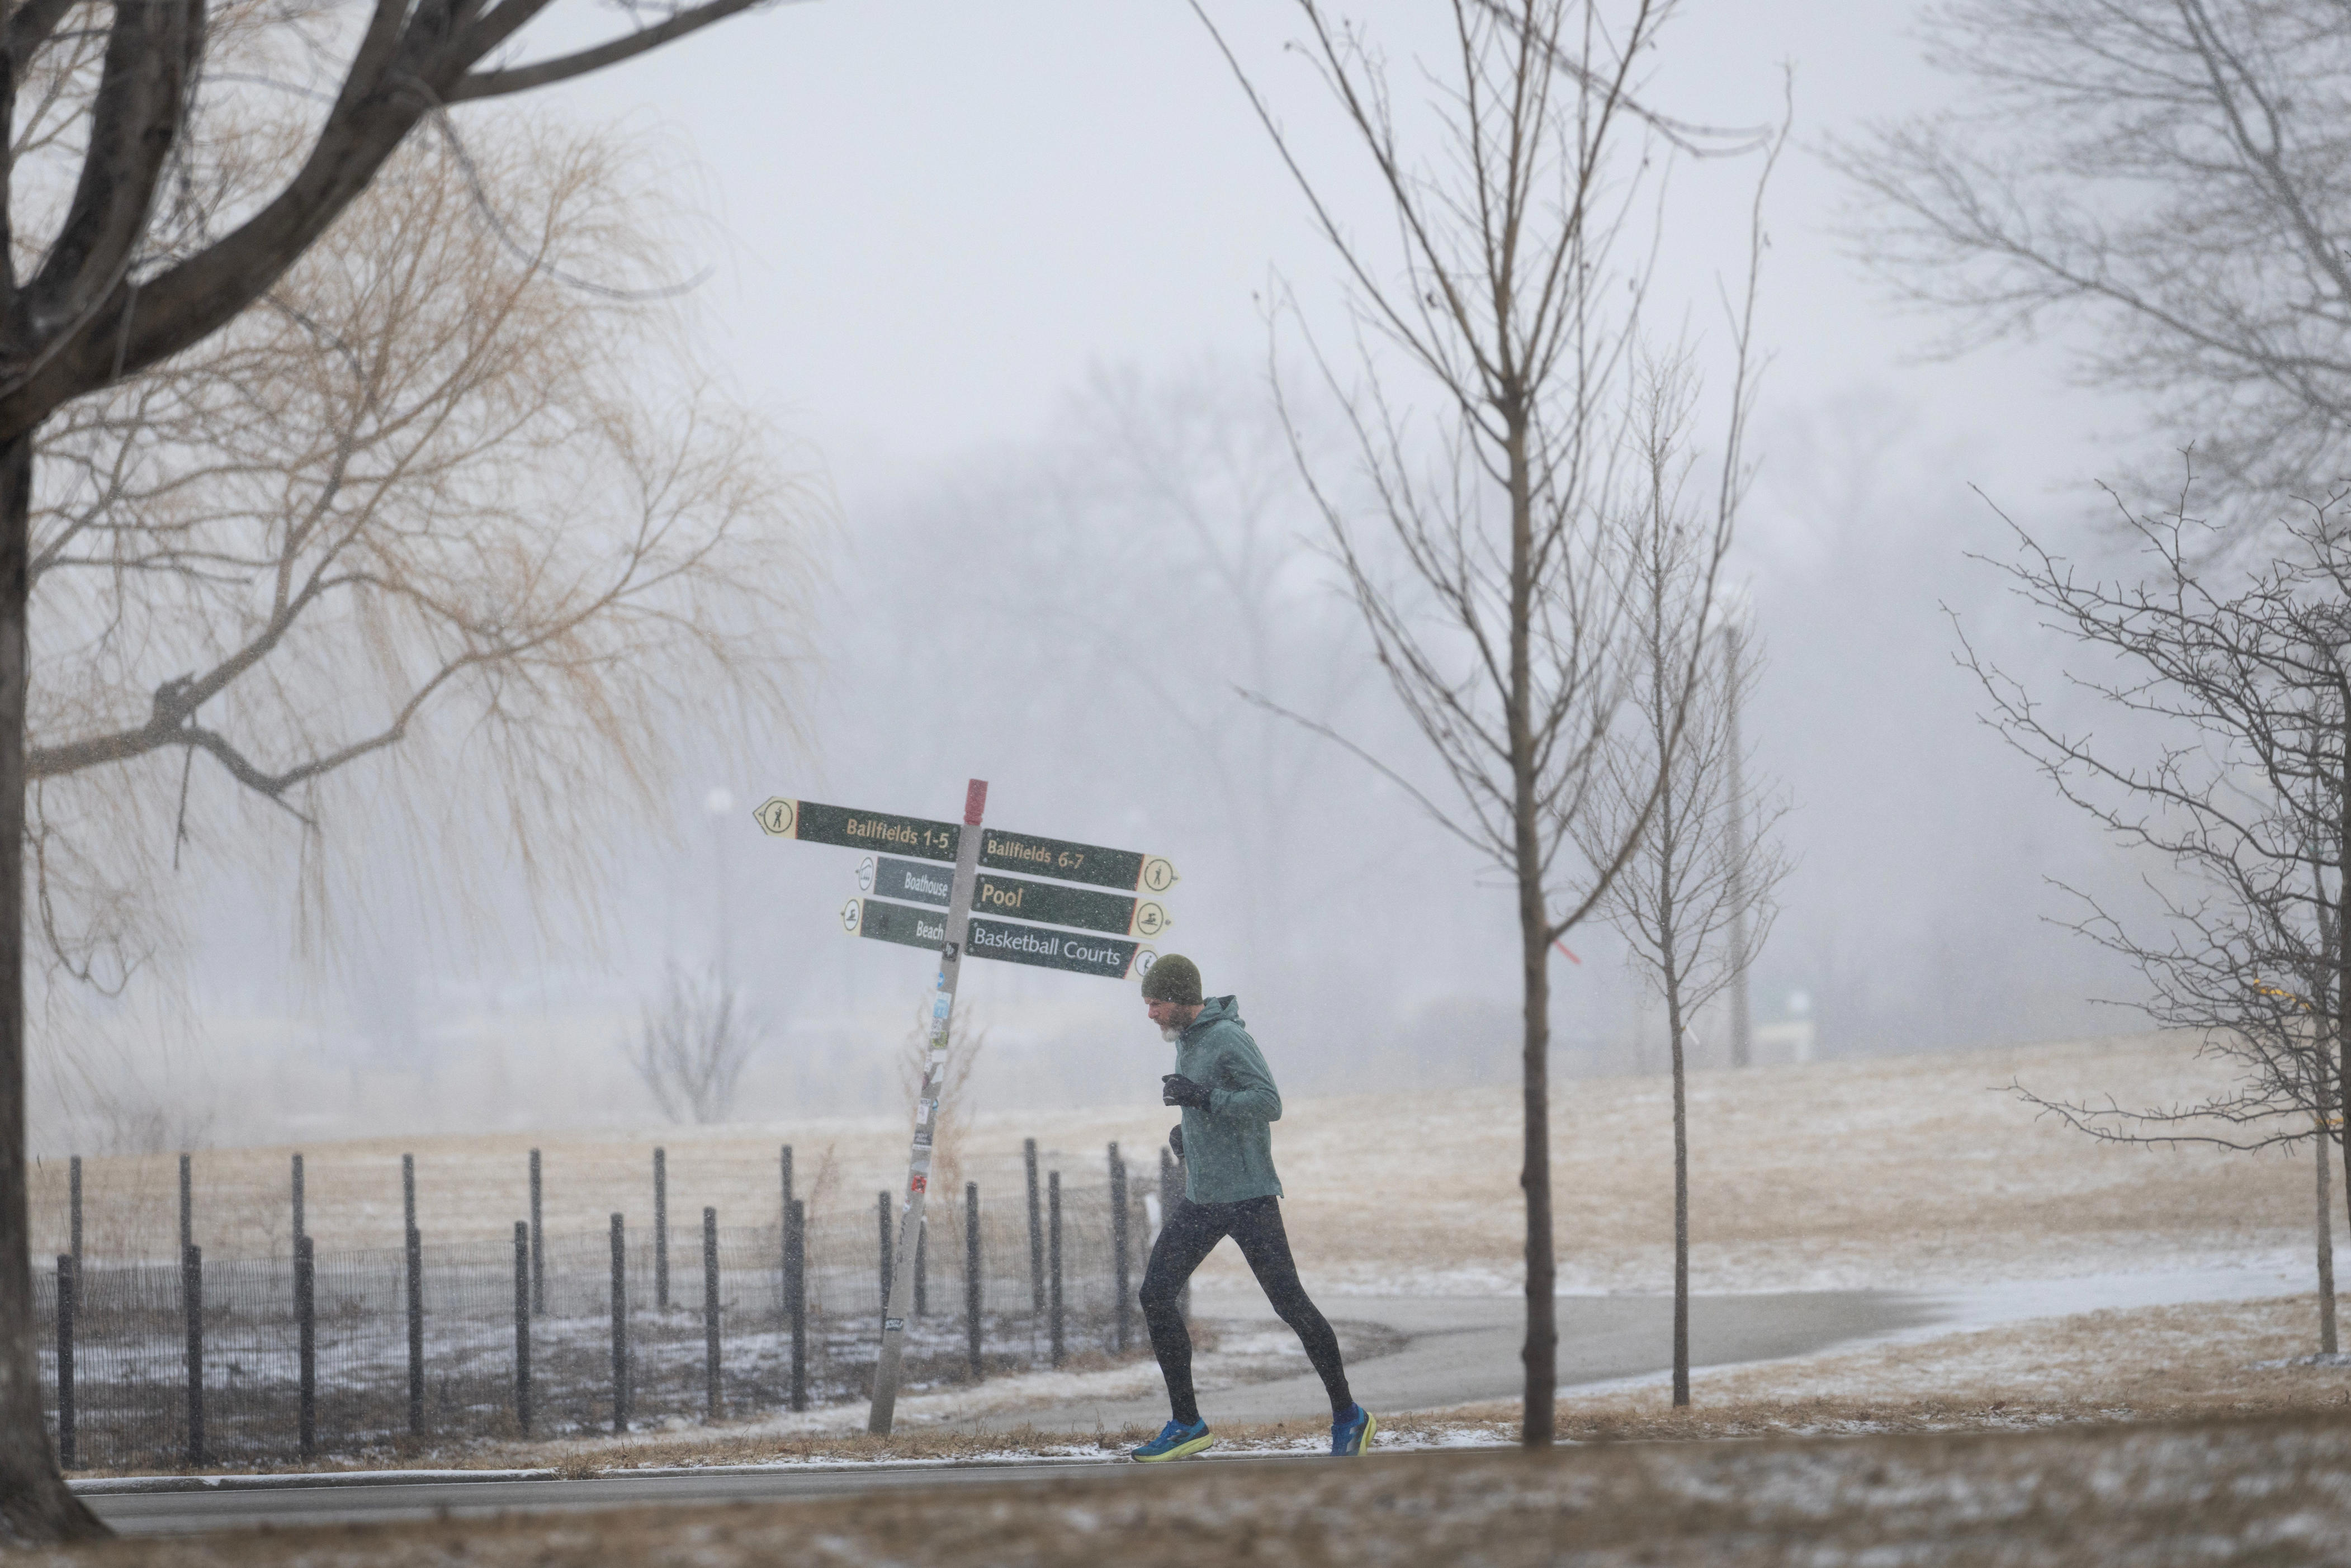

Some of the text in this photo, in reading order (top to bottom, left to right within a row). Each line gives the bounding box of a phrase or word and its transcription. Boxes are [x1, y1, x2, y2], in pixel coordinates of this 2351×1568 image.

[846, 818, 949, 849] Ballfields 1-5
[987, 839, 1085, 869] Ballfields 6-7
[904, 871, 948, 897] Boathouse
[981, 883, 1024, 908] Pool
[916, 920, 944, 941] Beach
[974, 927, 1120, 965] Basketball Courts
